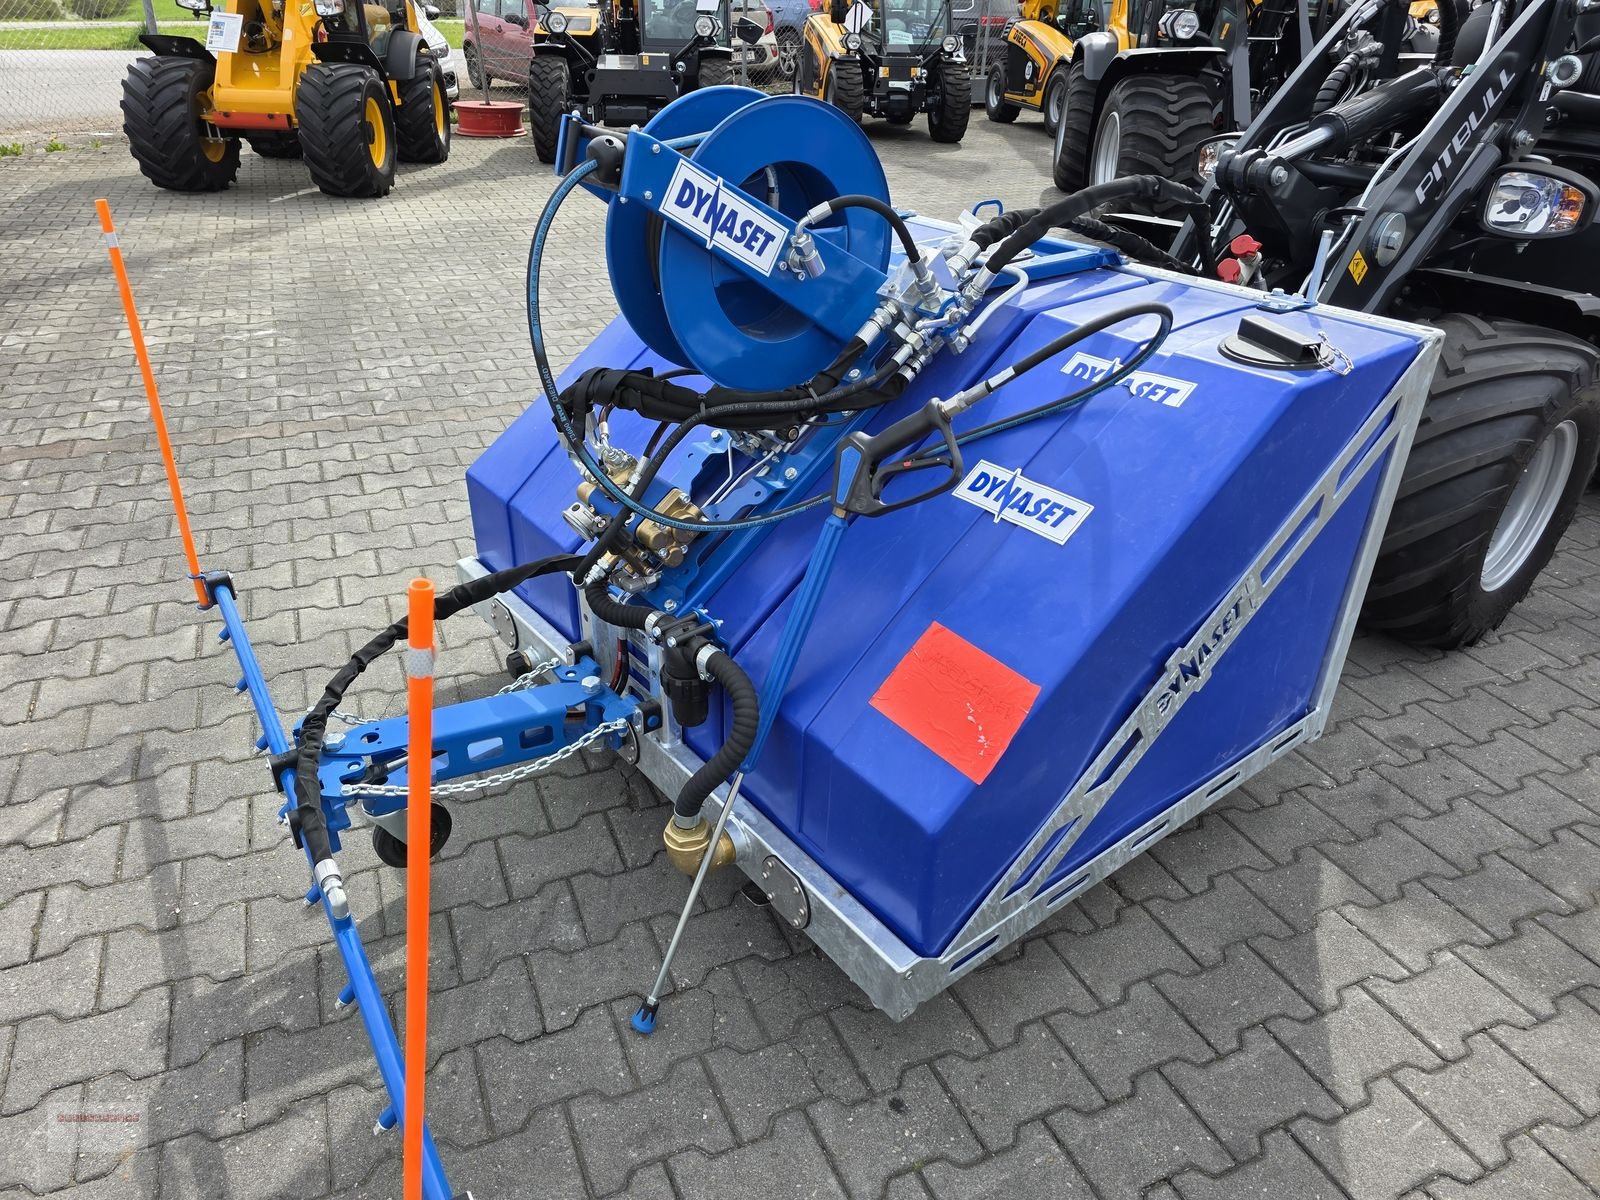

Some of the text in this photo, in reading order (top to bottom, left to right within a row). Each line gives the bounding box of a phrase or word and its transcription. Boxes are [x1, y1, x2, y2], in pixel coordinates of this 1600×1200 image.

[1012, 29, 1027, 48] DIECI
[1415, 69, 1516, 205] PITBULL
[674, 178, 776, 257] DYNASET
[542, 367, 558, 402] DIEHARD
[967, 471, 1077, 528] DYNASET
[1156, 596, 1243, 716] DYNASET
